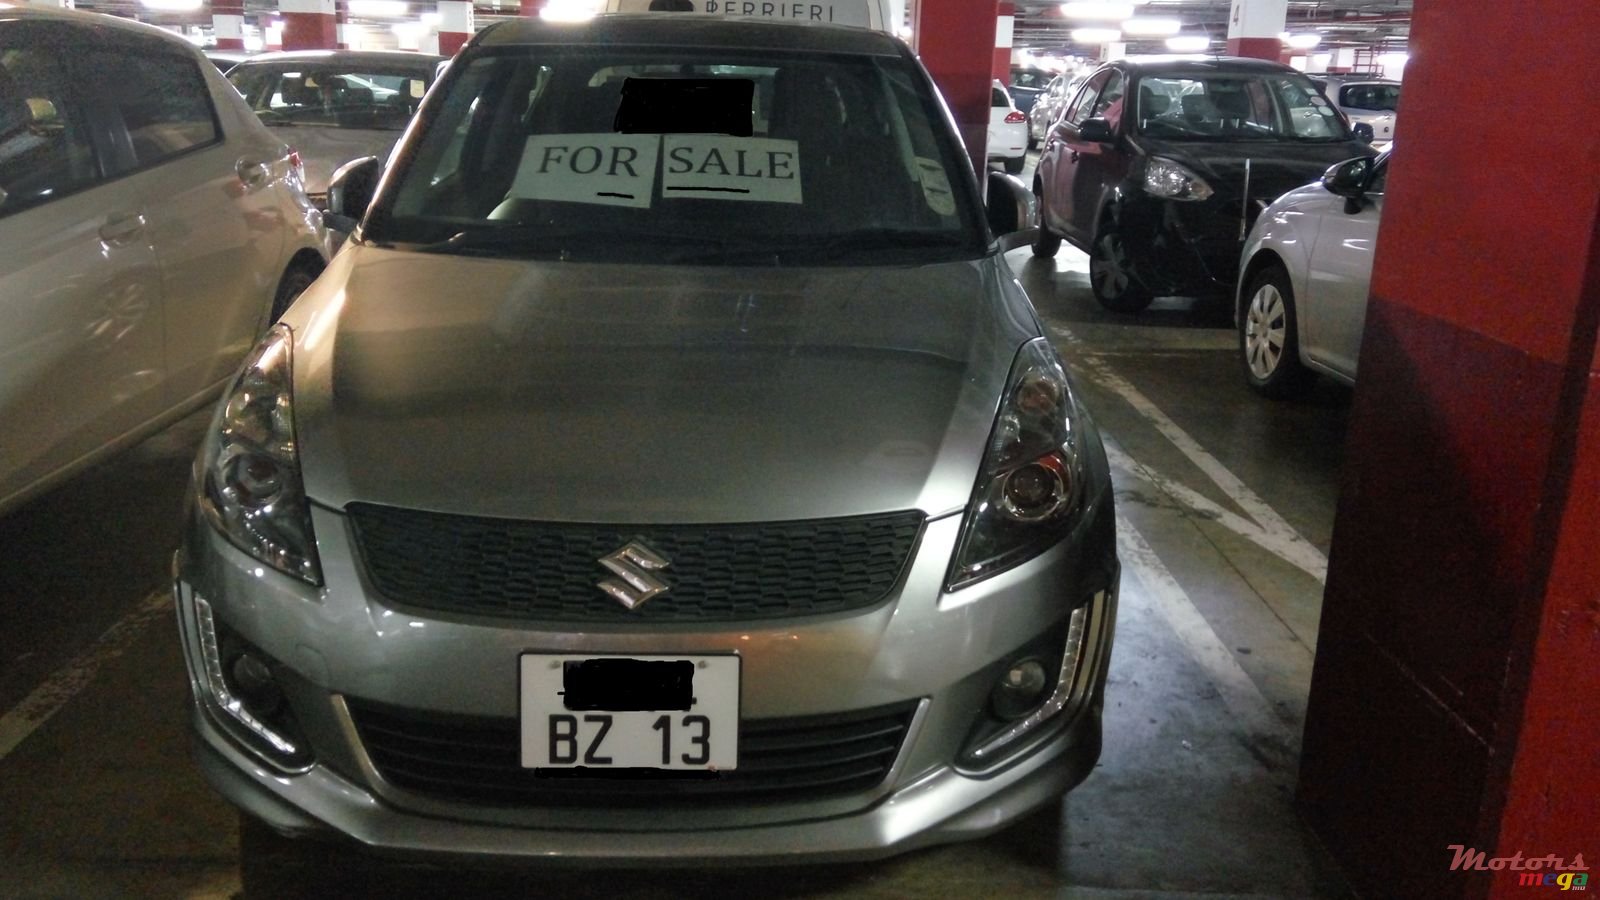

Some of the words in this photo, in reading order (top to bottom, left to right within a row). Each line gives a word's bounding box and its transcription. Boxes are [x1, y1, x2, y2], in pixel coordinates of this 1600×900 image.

[536, 146, 639, 177] FOR
[668, 147, 794, 180] SALE
[549, 714, 613, 765] BZ
[652, 715, 710, 765] 13
